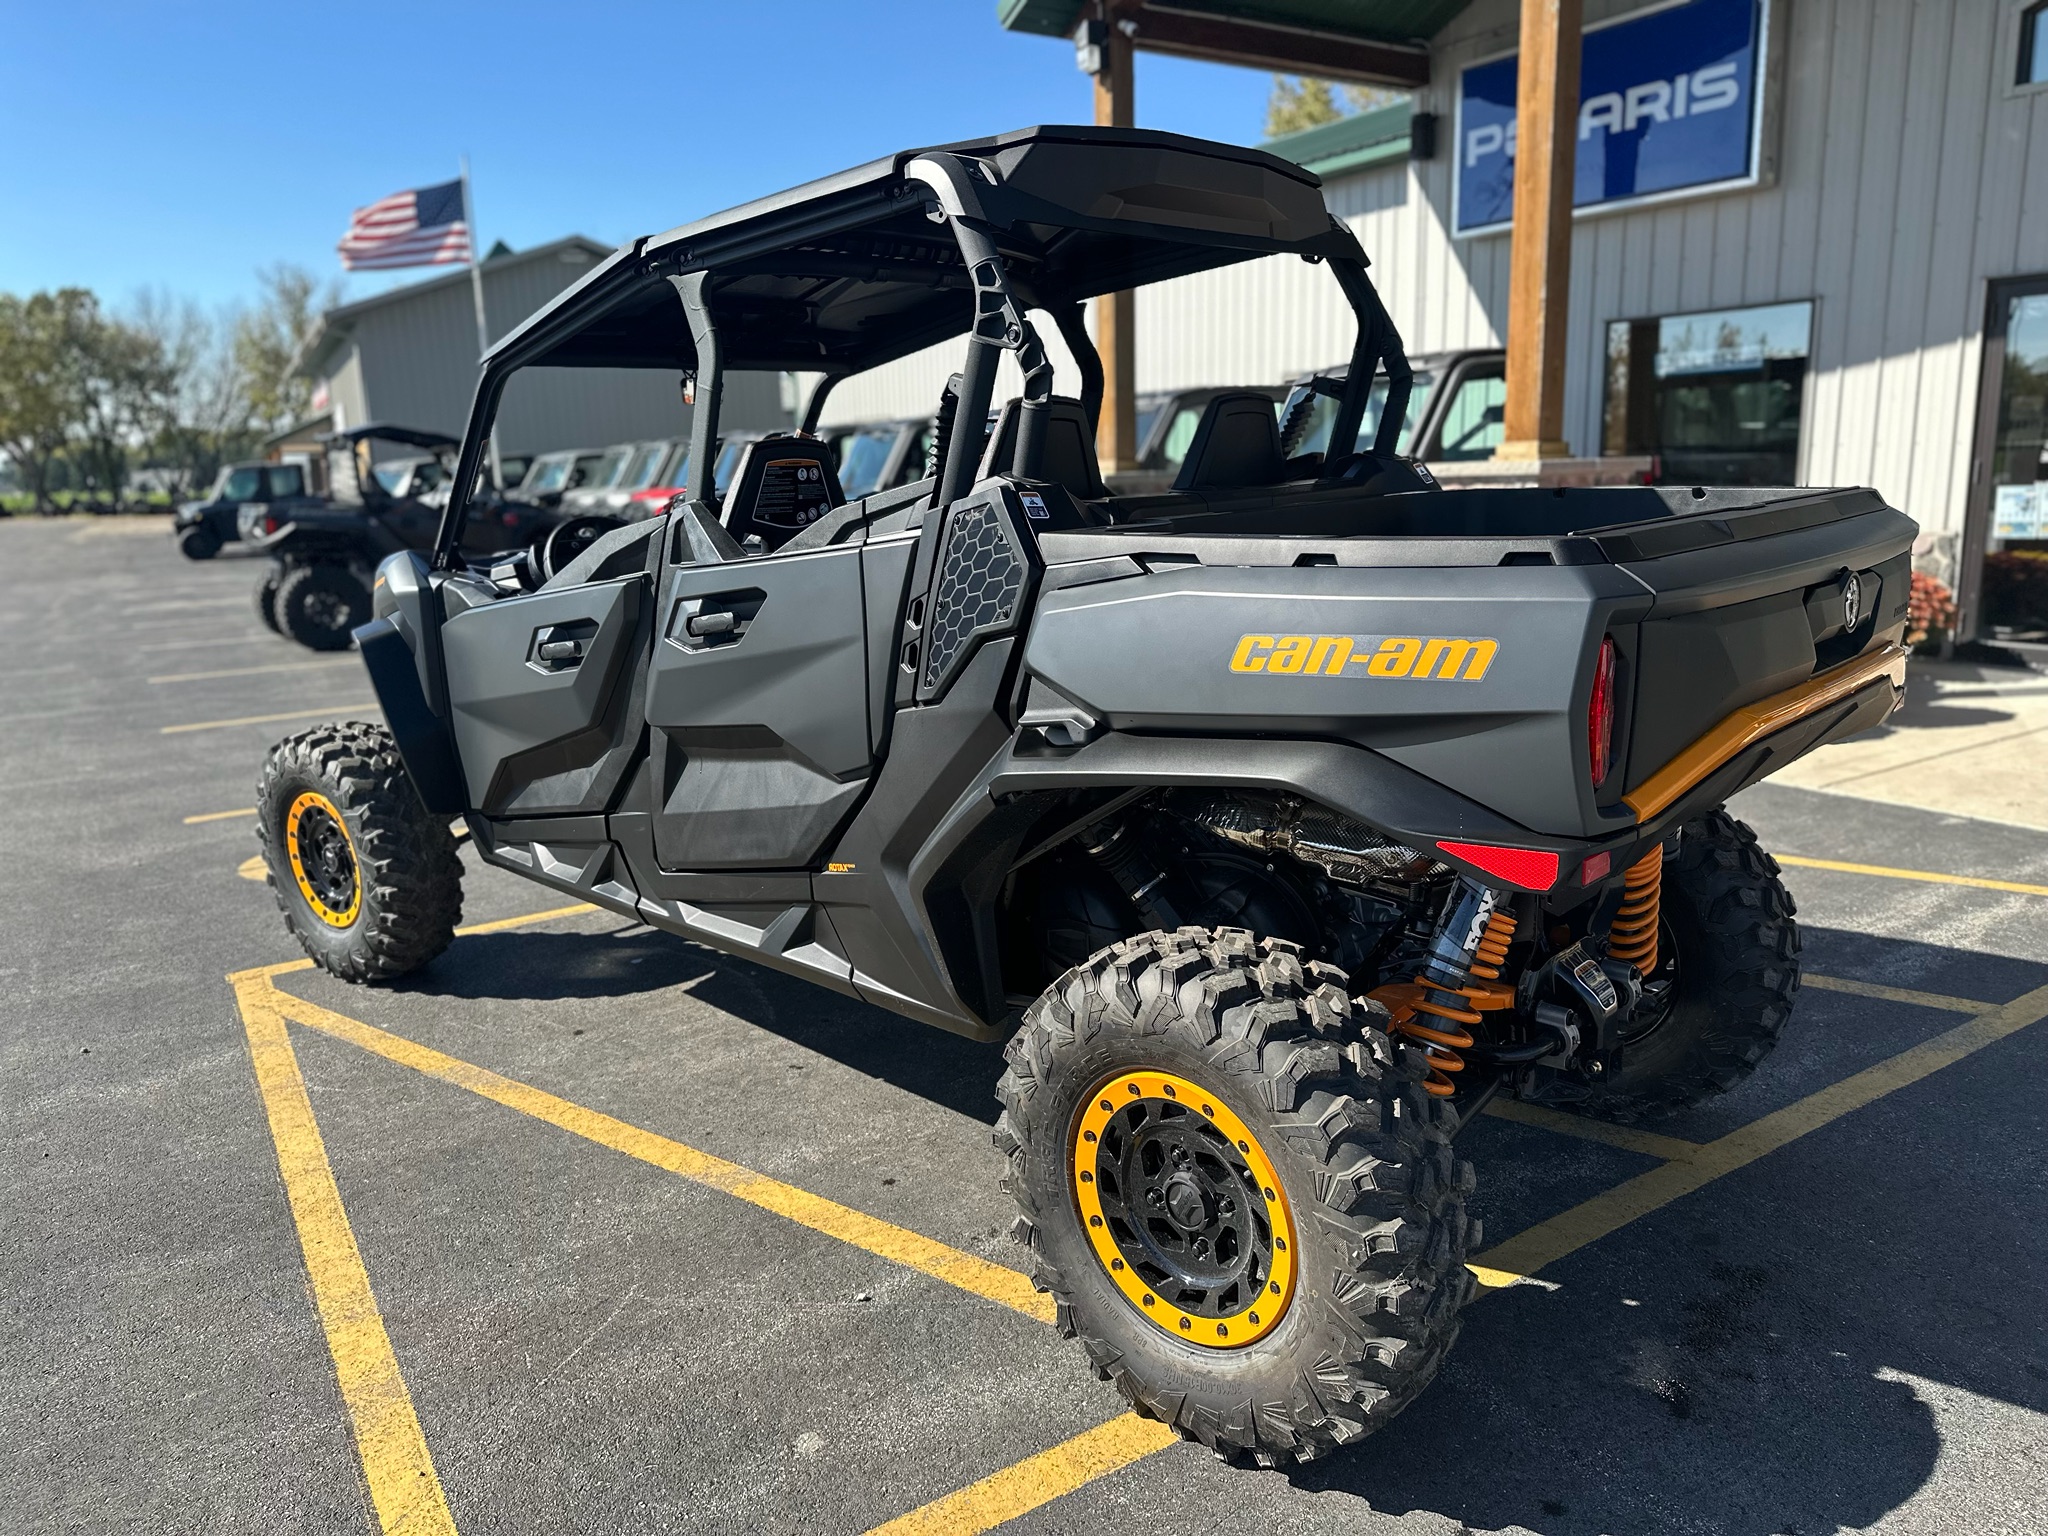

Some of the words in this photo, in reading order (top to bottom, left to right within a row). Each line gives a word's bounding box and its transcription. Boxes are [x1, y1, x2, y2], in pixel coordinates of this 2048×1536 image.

[1466, 62, 1740, 168] PARIS
[1230, 636, 1498, 680] can-am
[1463, 890, 1499, 950] FOX
[1051, 1048, 1112, 1119] FORCE
[1093, 1288, 1119, 1321] RADIAL
[1132, 1332, 1147, 1349] 8PR
